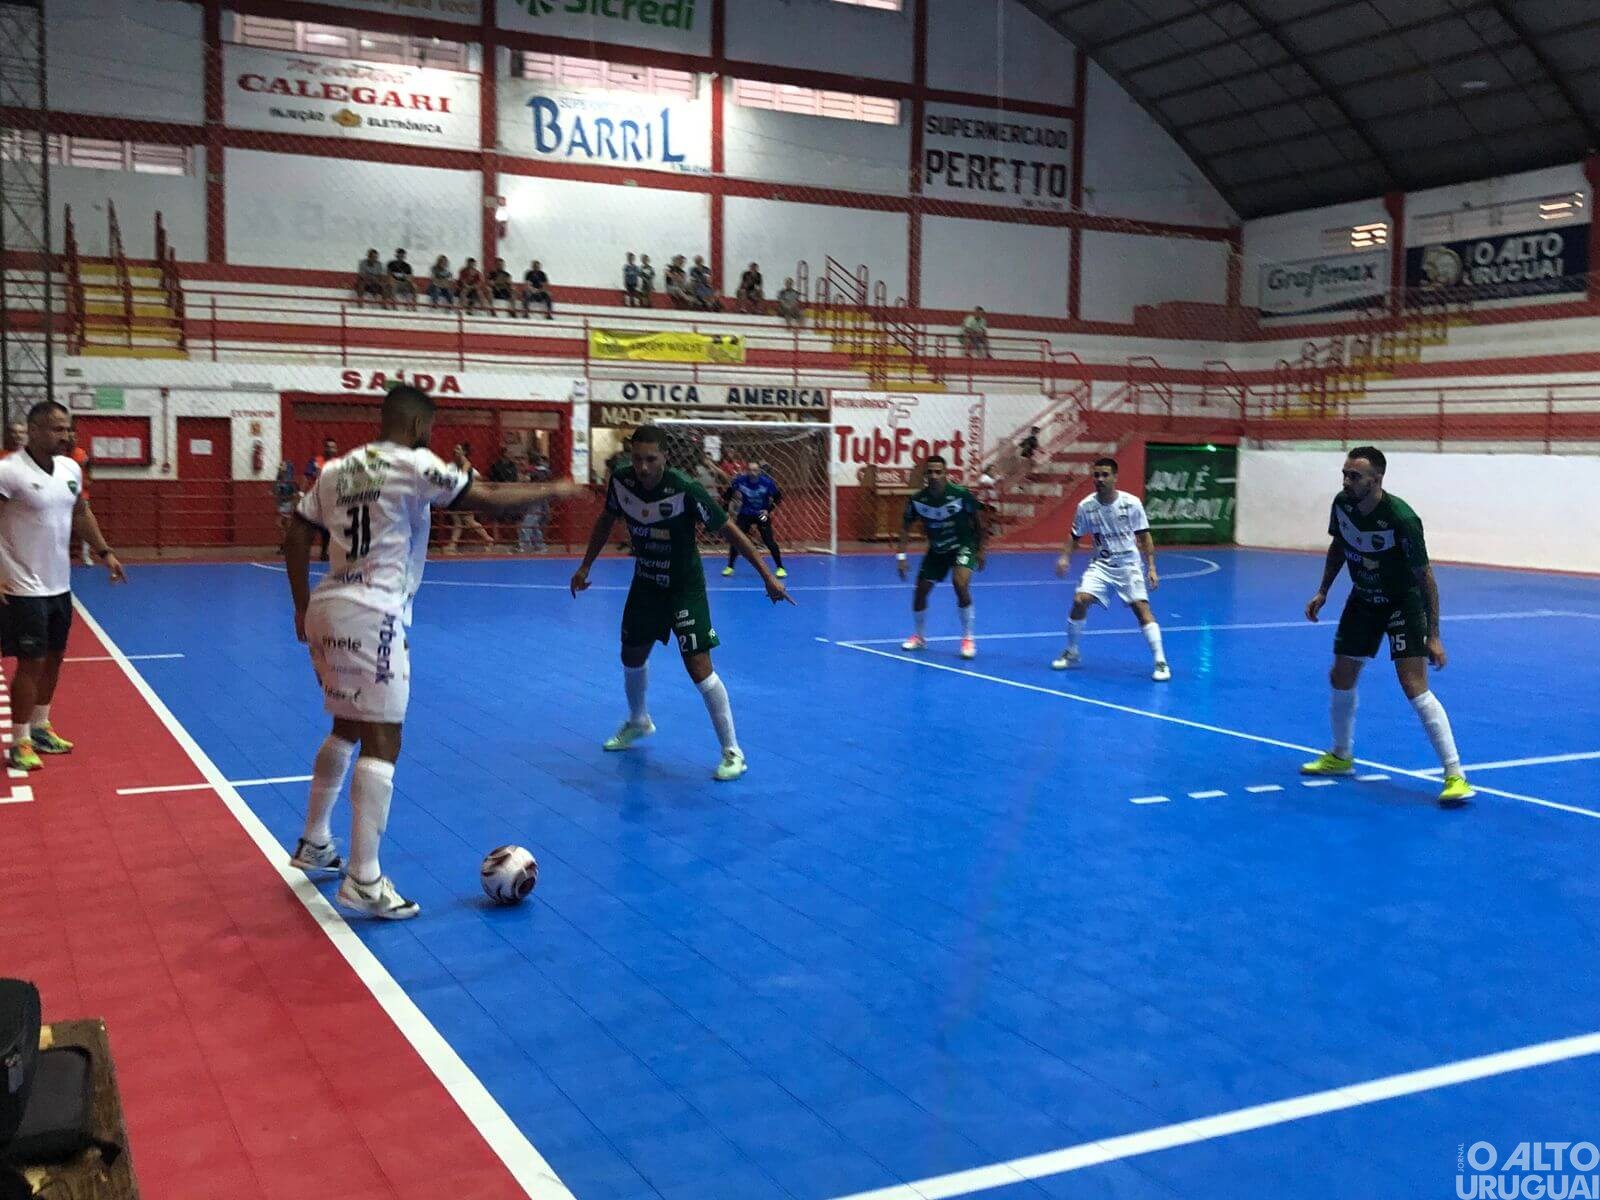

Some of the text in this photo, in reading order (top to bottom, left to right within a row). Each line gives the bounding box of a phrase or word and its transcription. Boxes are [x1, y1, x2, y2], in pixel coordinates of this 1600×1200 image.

[237, 73, 452, 113] CALEGARI
[926, 114, 1068, 150] SUPERMERCADO
[926, 149, 1067, 198] PERETTO
[1474, 232, 1564, 265] O ALTO
[1267, 261, 1377, 298] Grafimax
[835, 426, 966, 467] TubFort
[679, 632, 698, 652] 21
